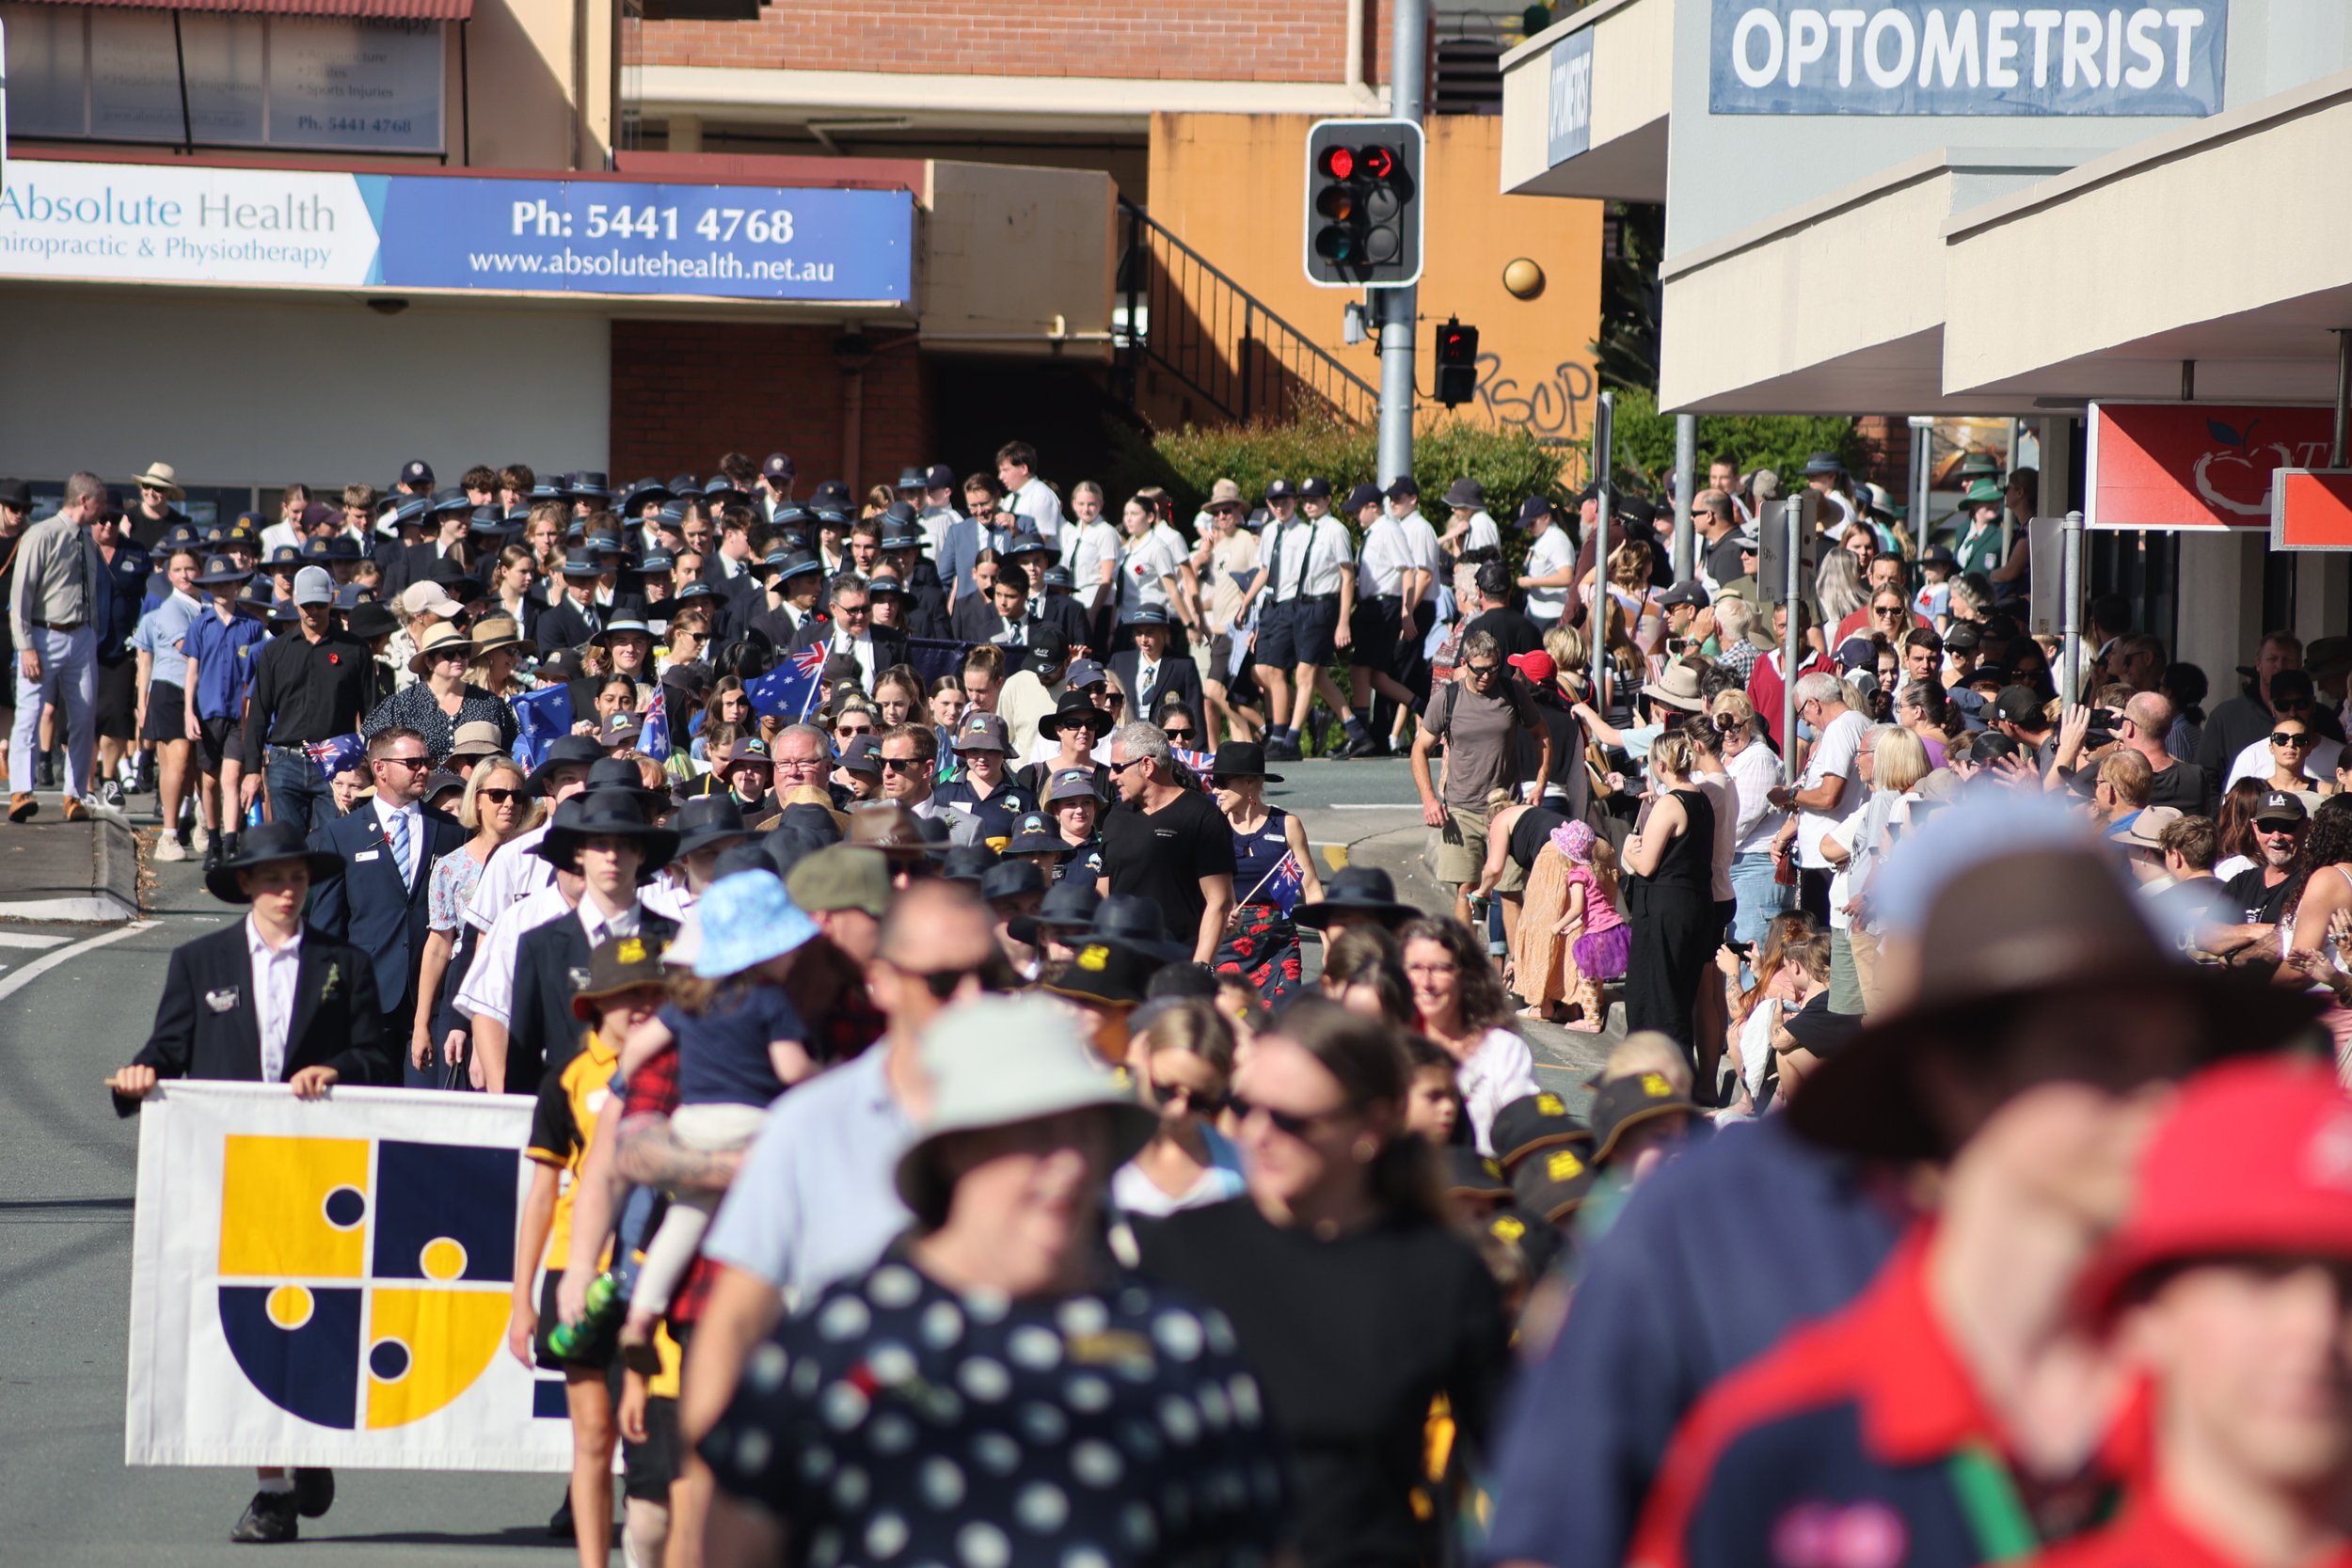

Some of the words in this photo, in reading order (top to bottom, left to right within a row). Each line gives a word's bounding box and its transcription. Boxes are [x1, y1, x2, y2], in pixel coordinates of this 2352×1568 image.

[1732, 8, 2204, 88] OPTOMETRIST
[307, 84, 344, 99] Sports
[348, 84, 394, 100] Injuries
[297, 114, 323, 132] Ph.
[329, 117, 366, 133] 5441
[372, 118, 412, 134] 4768
[0, 182, 182, 227] Absolute
[199, 192, 335, 232] Health
[512, 199, 572, 238] Ph:
[586, 204, 678, 241] 5441
[696, 208, 795, 244] 4768
[137, 236, 155, 258] &
[166, 236, 332, 269] Physiotherapy
[469, 247, 834, 282] www.absolutehealth.net.au
[2269, 795, 2287, 803] LA
